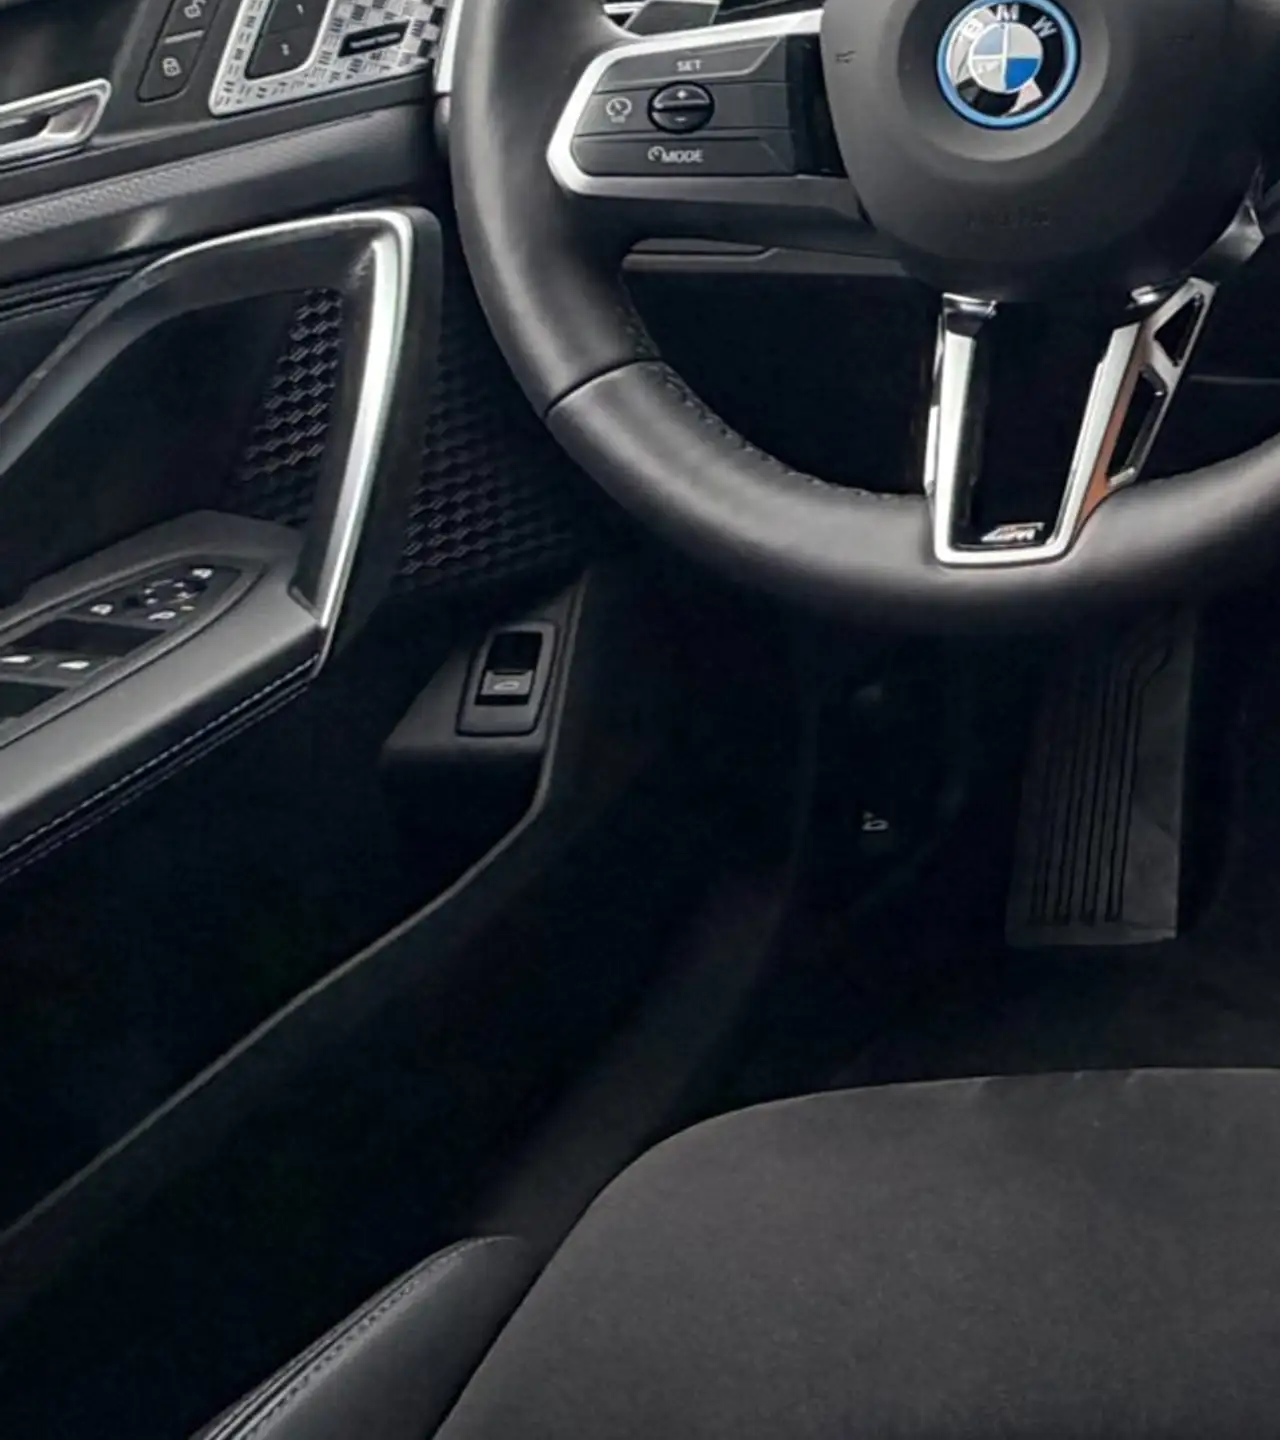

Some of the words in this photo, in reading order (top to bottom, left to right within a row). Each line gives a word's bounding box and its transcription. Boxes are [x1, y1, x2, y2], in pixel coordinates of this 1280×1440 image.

[961, 3, 1058, 40] BMW
[676, 59, 703, 73] SET
[662, 148, 705, 164] MODE
